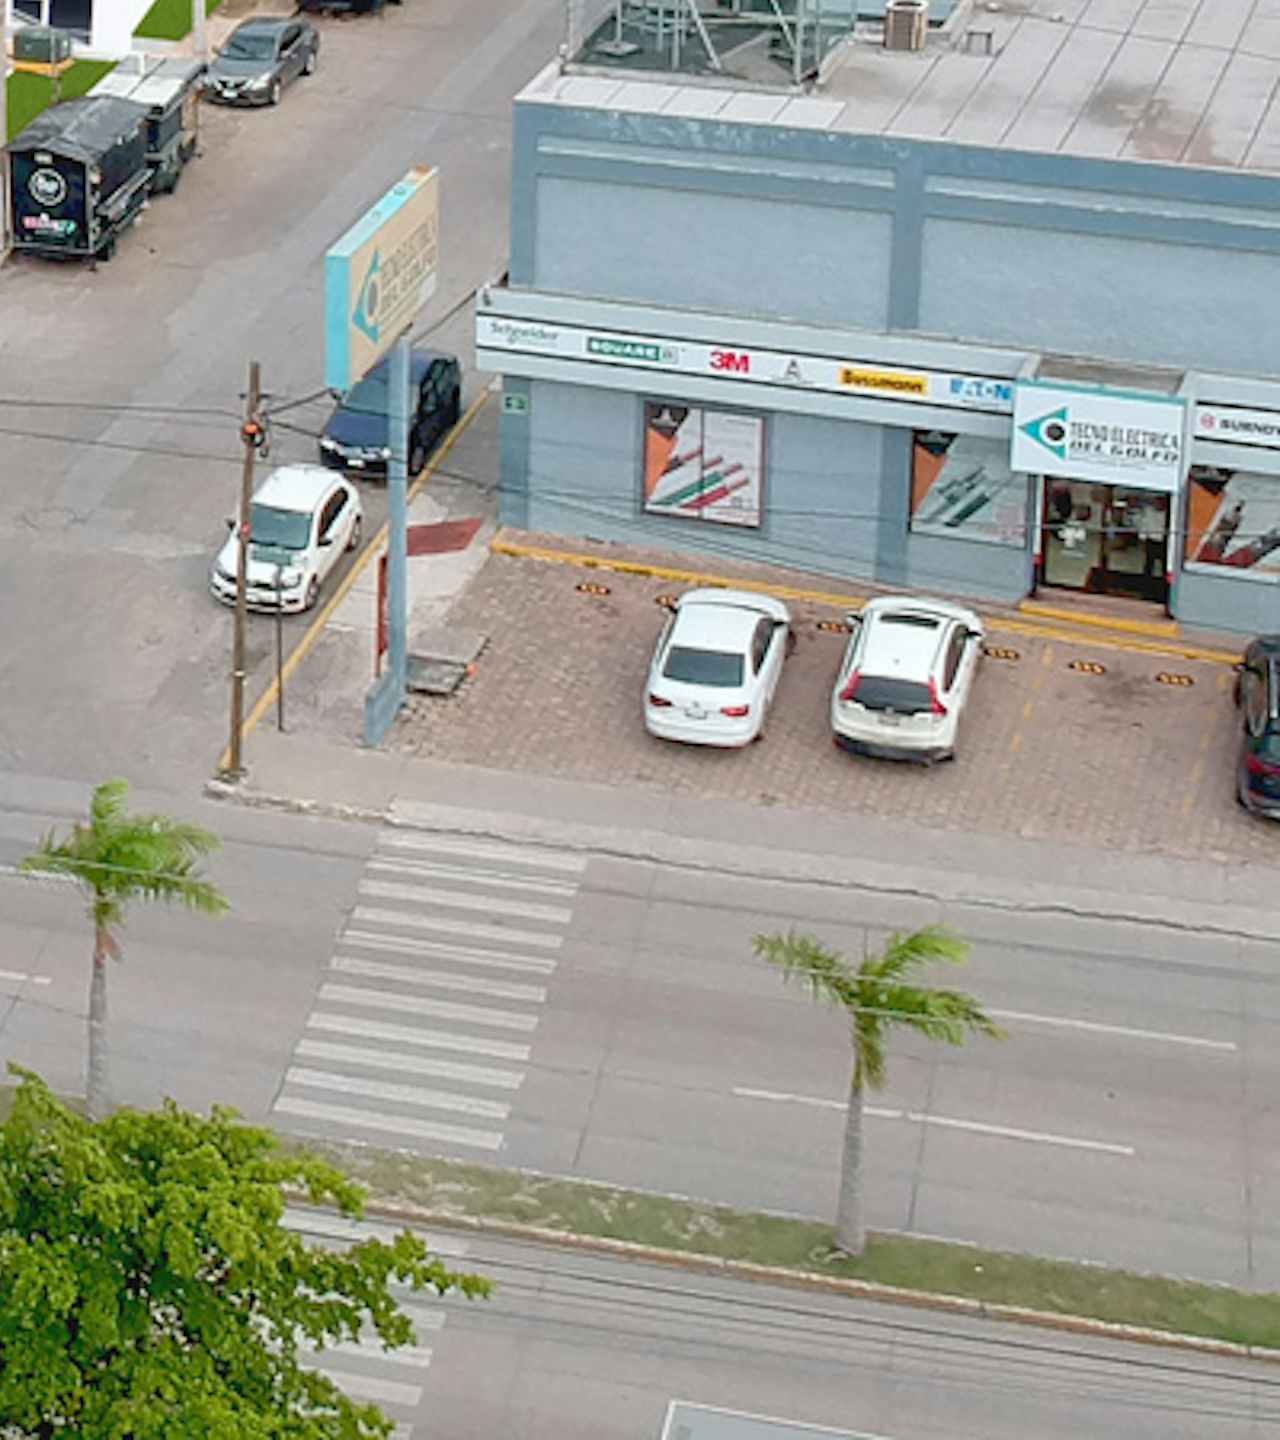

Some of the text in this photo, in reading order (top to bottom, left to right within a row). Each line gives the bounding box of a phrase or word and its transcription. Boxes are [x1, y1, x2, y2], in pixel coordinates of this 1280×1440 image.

[709, 350, 750, 373] 3M
[1070, 421, 1178, 449] TECNO ELECTRICA
[1069, 441, 1179, 462] DEL GOLFO
